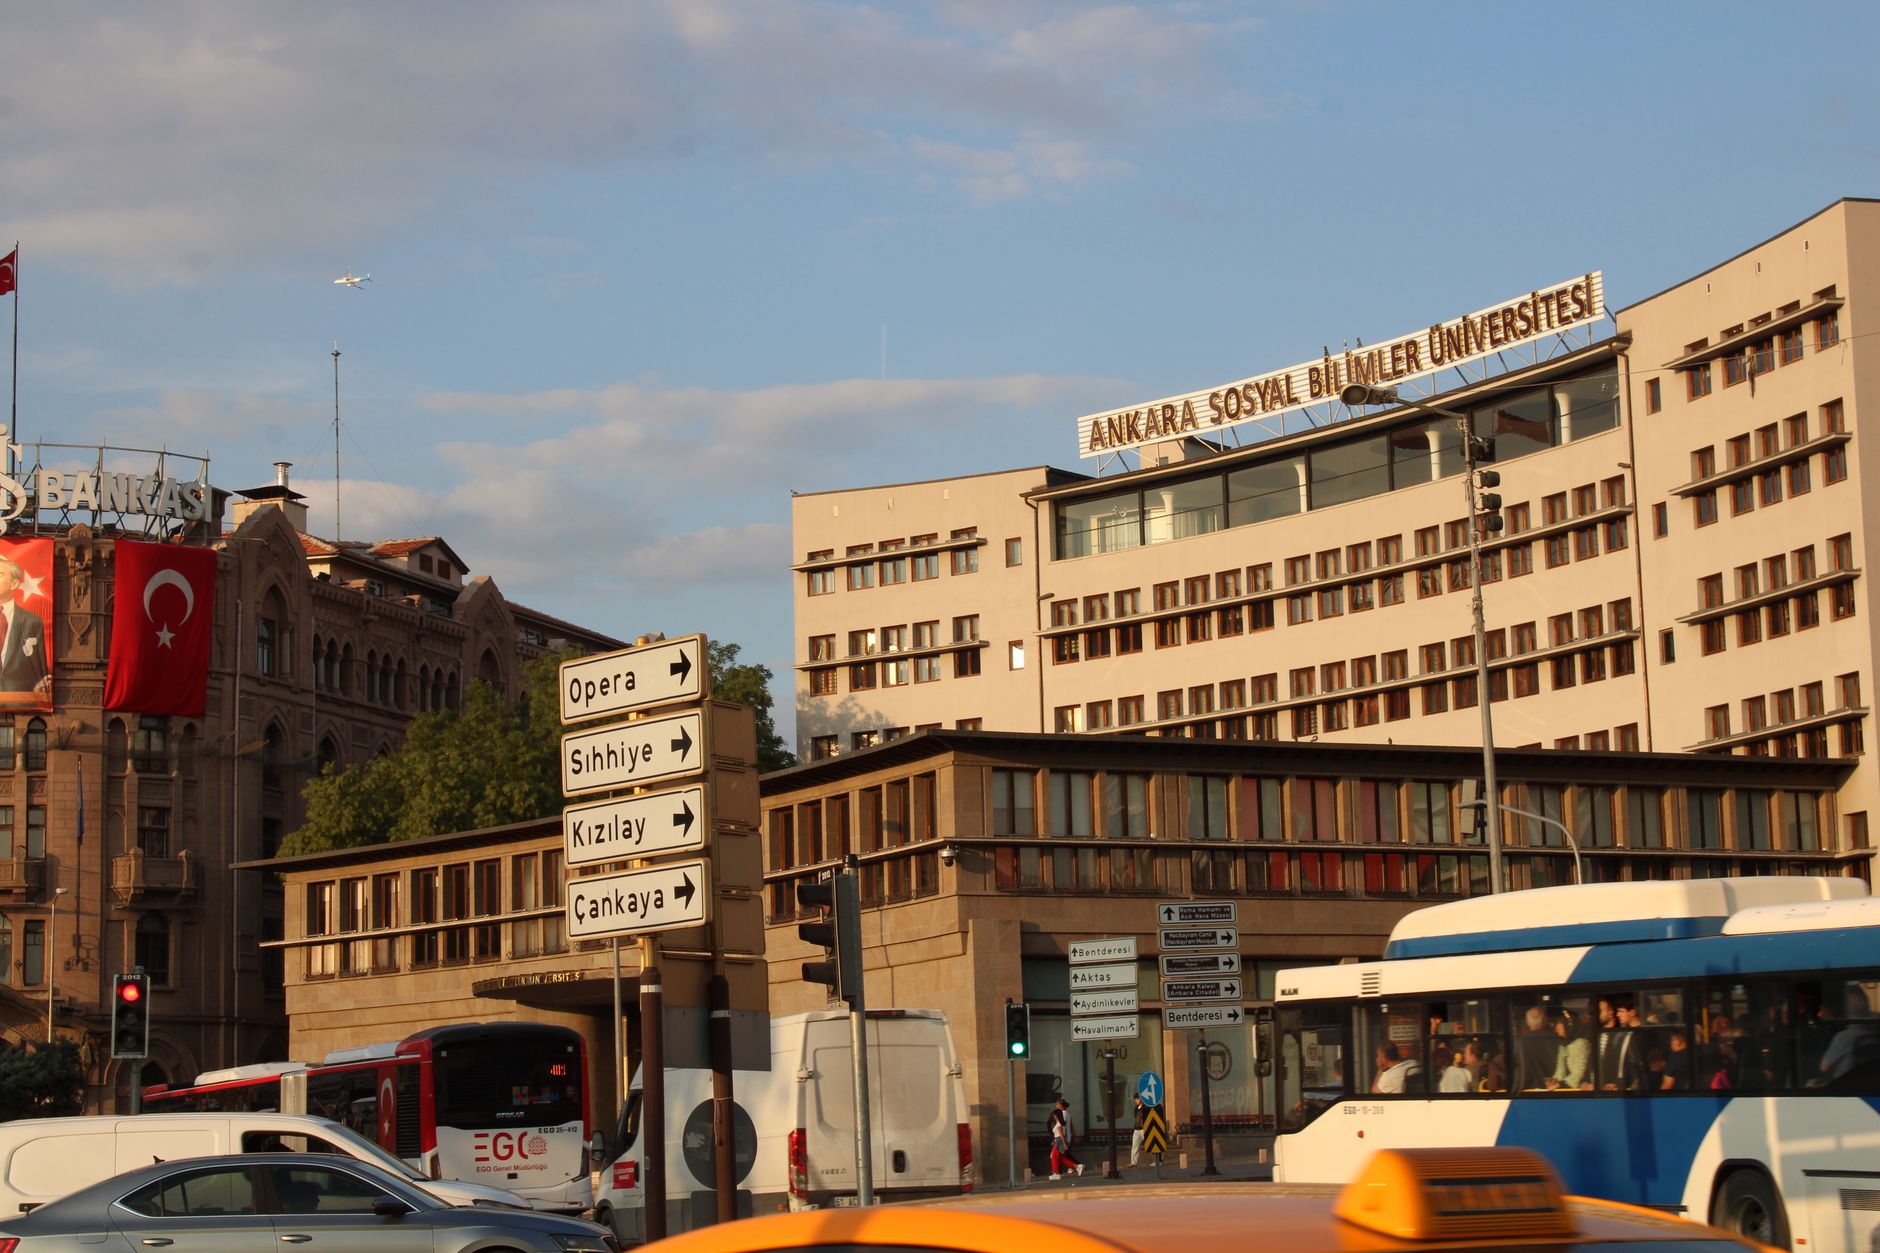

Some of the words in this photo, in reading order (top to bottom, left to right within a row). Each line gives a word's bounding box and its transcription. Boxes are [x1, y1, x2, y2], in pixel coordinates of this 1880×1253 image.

[1089, 400, 1200, 450] ANKARA
[1209, 374, 1301, 425] SOSYAL
[1309, 340, 1421, 398] BİLİMLER
[1429, 272, 1595, 365] ÜNİVERSİTESİ
[39, 470, 212, 523] BANKASI
[569, 671, 636, 708] Opera
[571, 741, 653, 775] Sıhhiye
[573, 814, 646, 848] Kızılay
[575, 888, 664, 925] Çankaya
[1079, 946, 1131, 957] Bentderesi
[1081, 973, 1111, 983] Aktaş
[1281, 988, 1298, 996] MAN
[1168, 1010, 1223, 1023] Bentderesi
[1096, 1045, 1127, 1060] ABÜ
[476, 1165, 491, 1173] EGO
